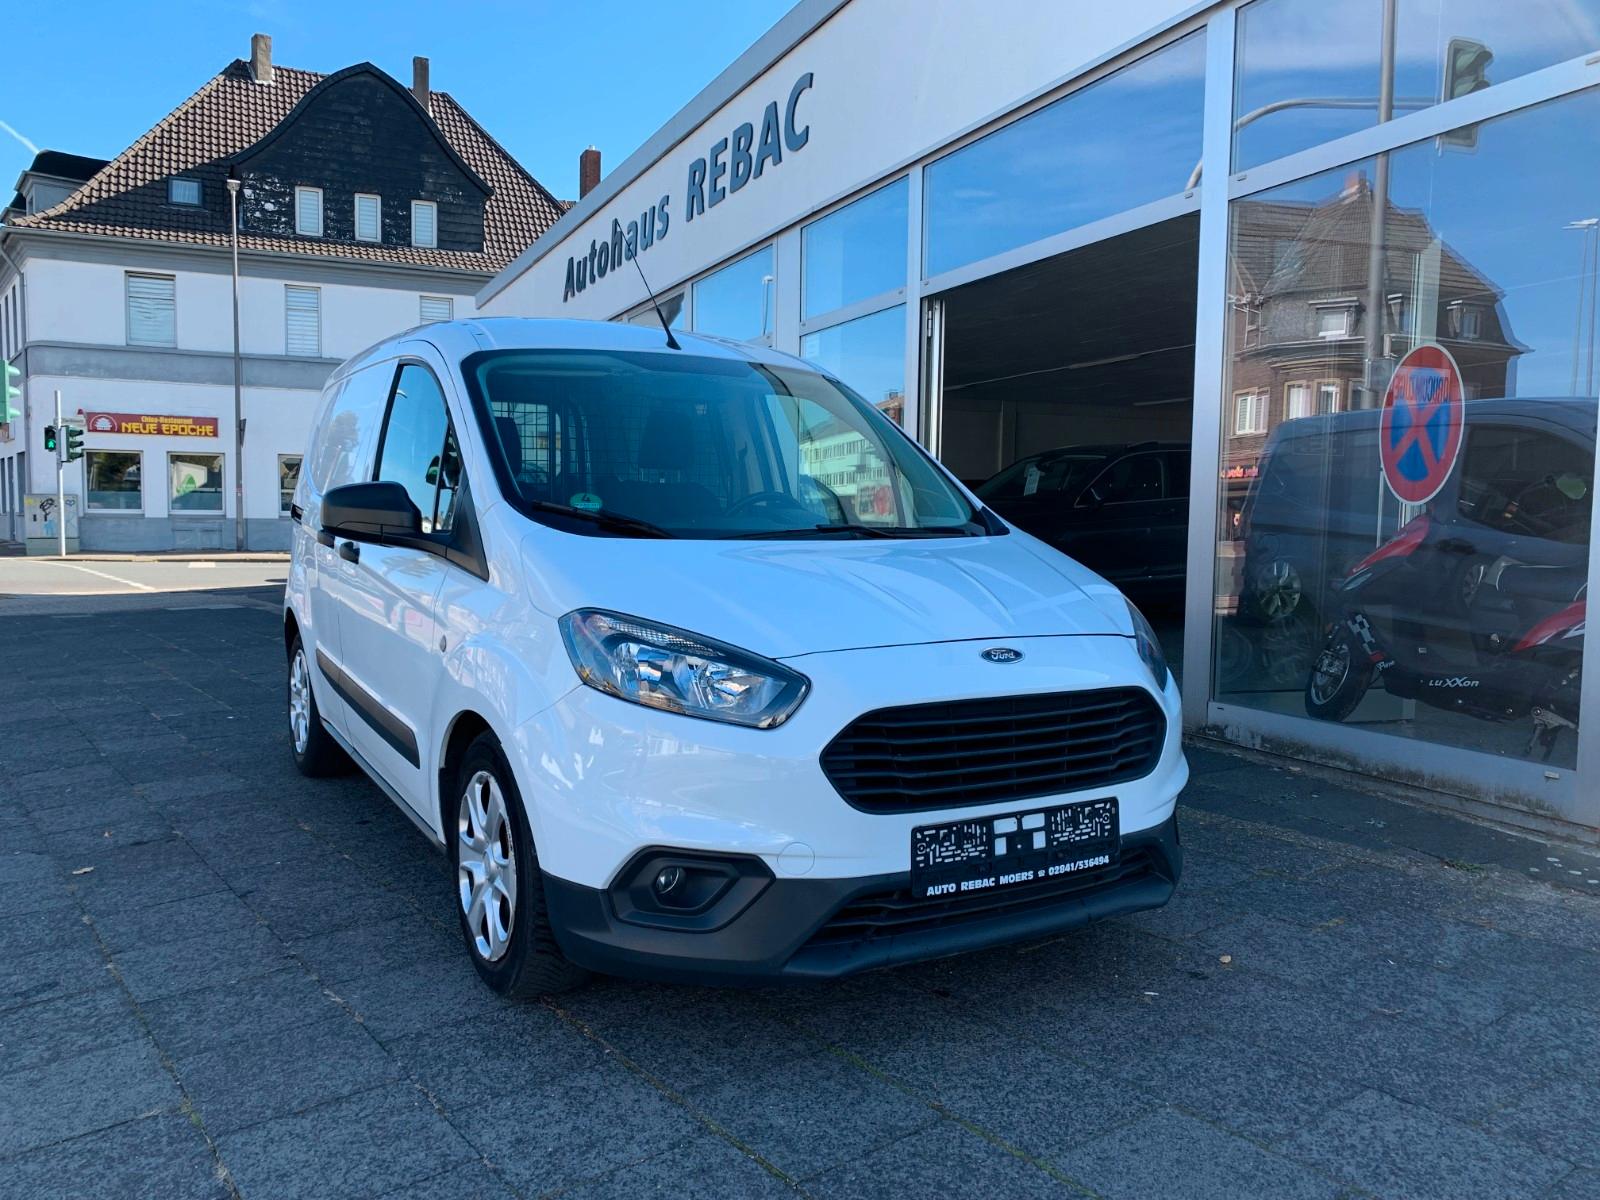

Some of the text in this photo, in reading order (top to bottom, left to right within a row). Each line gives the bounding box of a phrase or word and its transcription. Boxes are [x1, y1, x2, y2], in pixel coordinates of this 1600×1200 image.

[563, 72, 814, 303] Autohaus REBAC
[121, 422, 214, 436] NEUE EPOCHE
[991, 649, 1016, 660] Ford
[927, 883, 956, 896] AUTO
[960, 877, 996, 891] REBAC
[999, 870, 1034, 885] MOERS
